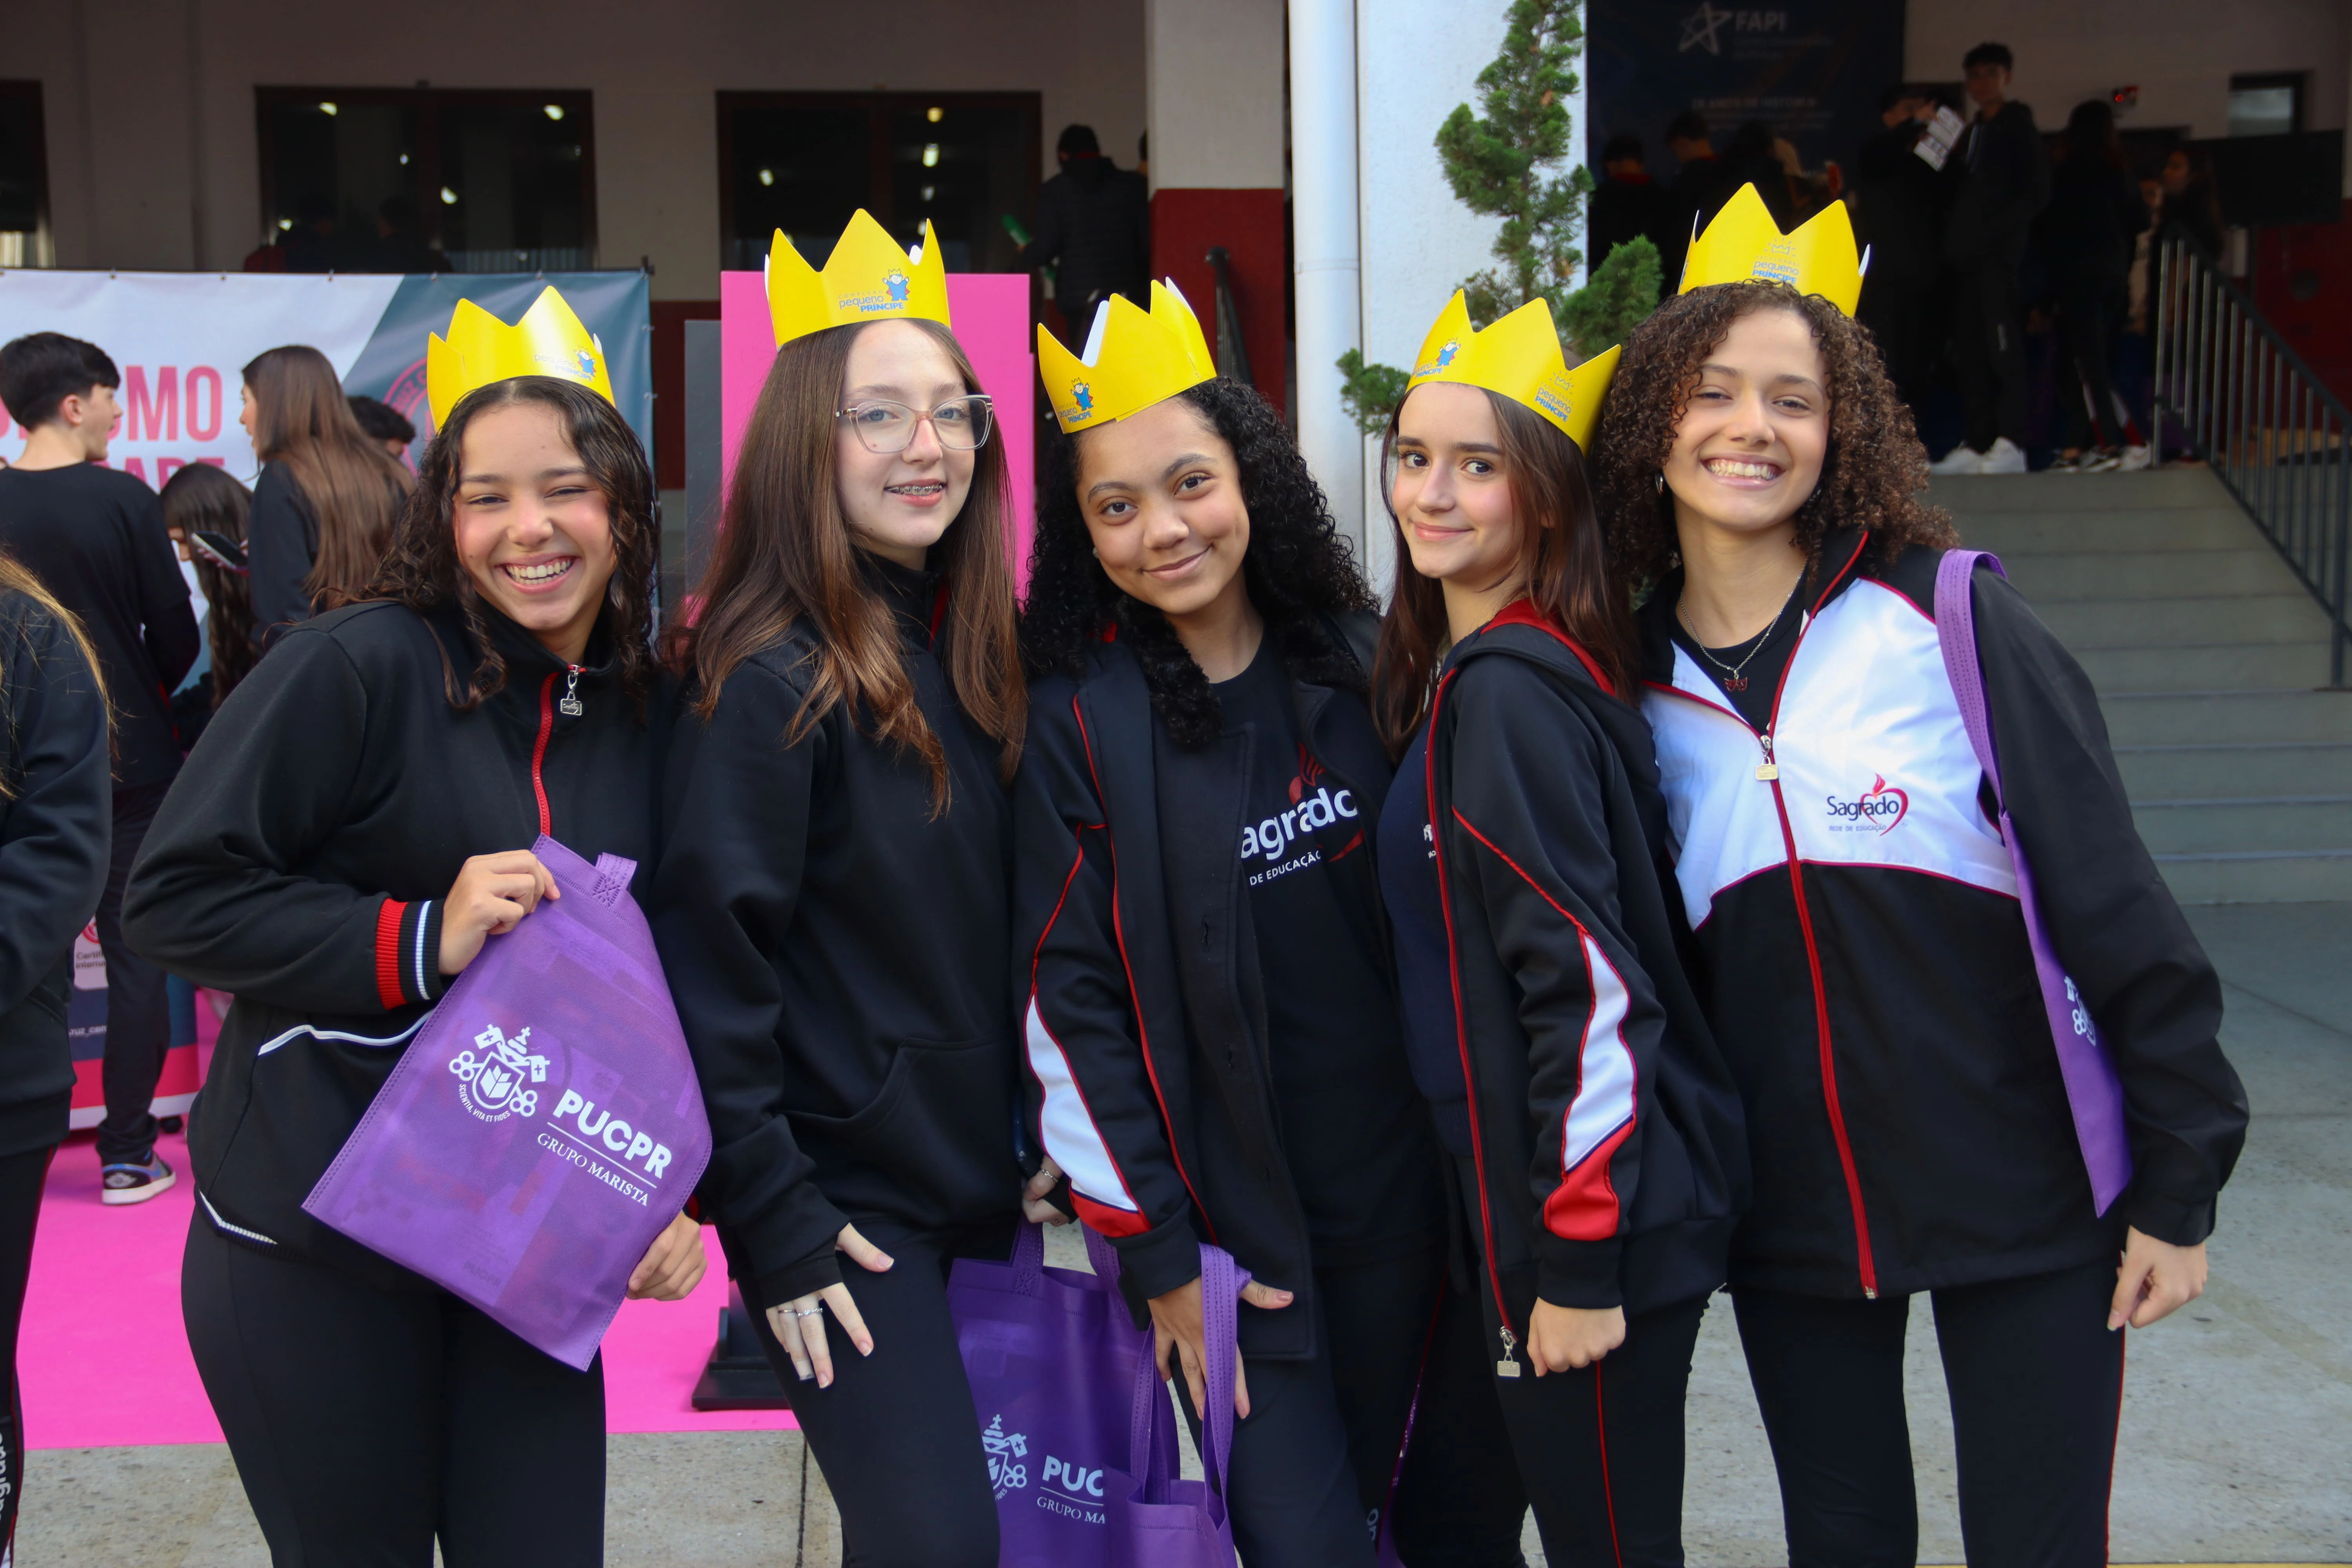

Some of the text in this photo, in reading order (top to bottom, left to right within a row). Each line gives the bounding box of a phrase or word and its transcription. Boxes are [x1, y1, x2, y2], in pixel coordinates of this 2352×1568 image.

[1735, 12, 1787, 31] FAPI
[1754, 261, 1799, 275] pequeno
[838, 290, 883, 299] COMPLEXO
[839, 296, 884, 310] pequeno
[860, 302, 904, 312] PRÍNCIPE
[1537, 387, 1571, 413] pequeno
[1827, 796, 1899, 821] Sagrado
[1856, 824, 1887, 832] EDUCAÇÃO
[1249, 873, 1263, 886] DE
[459, 1083, 473, 1113] SCIENTIA,
[473, 1109, 485, 1120] VITA
[494, 1111, 511, 1122] FIDES
[553, 1089, 672, 1179] PUCPR
[537, 1133, 649, 1206] GRUPO MARISTA
[1042, 1455, 1103, 1497] PUC
[1037, 1496, 1082, 1519] GRUPO
